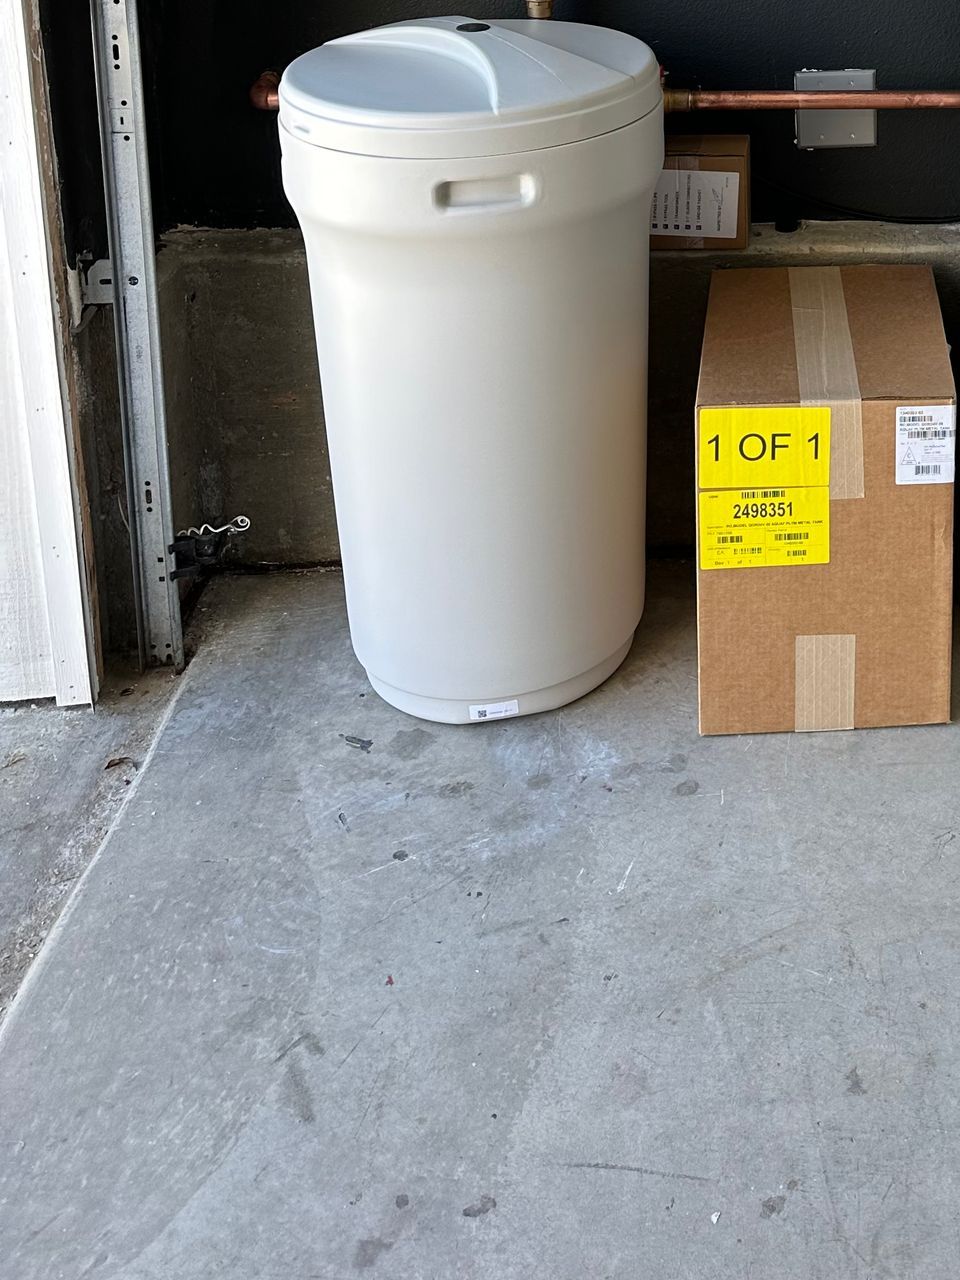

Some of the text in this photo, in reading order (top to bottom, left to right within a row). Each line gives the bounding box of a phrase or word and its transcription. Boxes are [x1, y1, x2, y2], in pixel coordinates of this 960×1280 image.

[707, 432, 819, 462] 1 OF 1
[733, 501, 793, 519] 2498351
